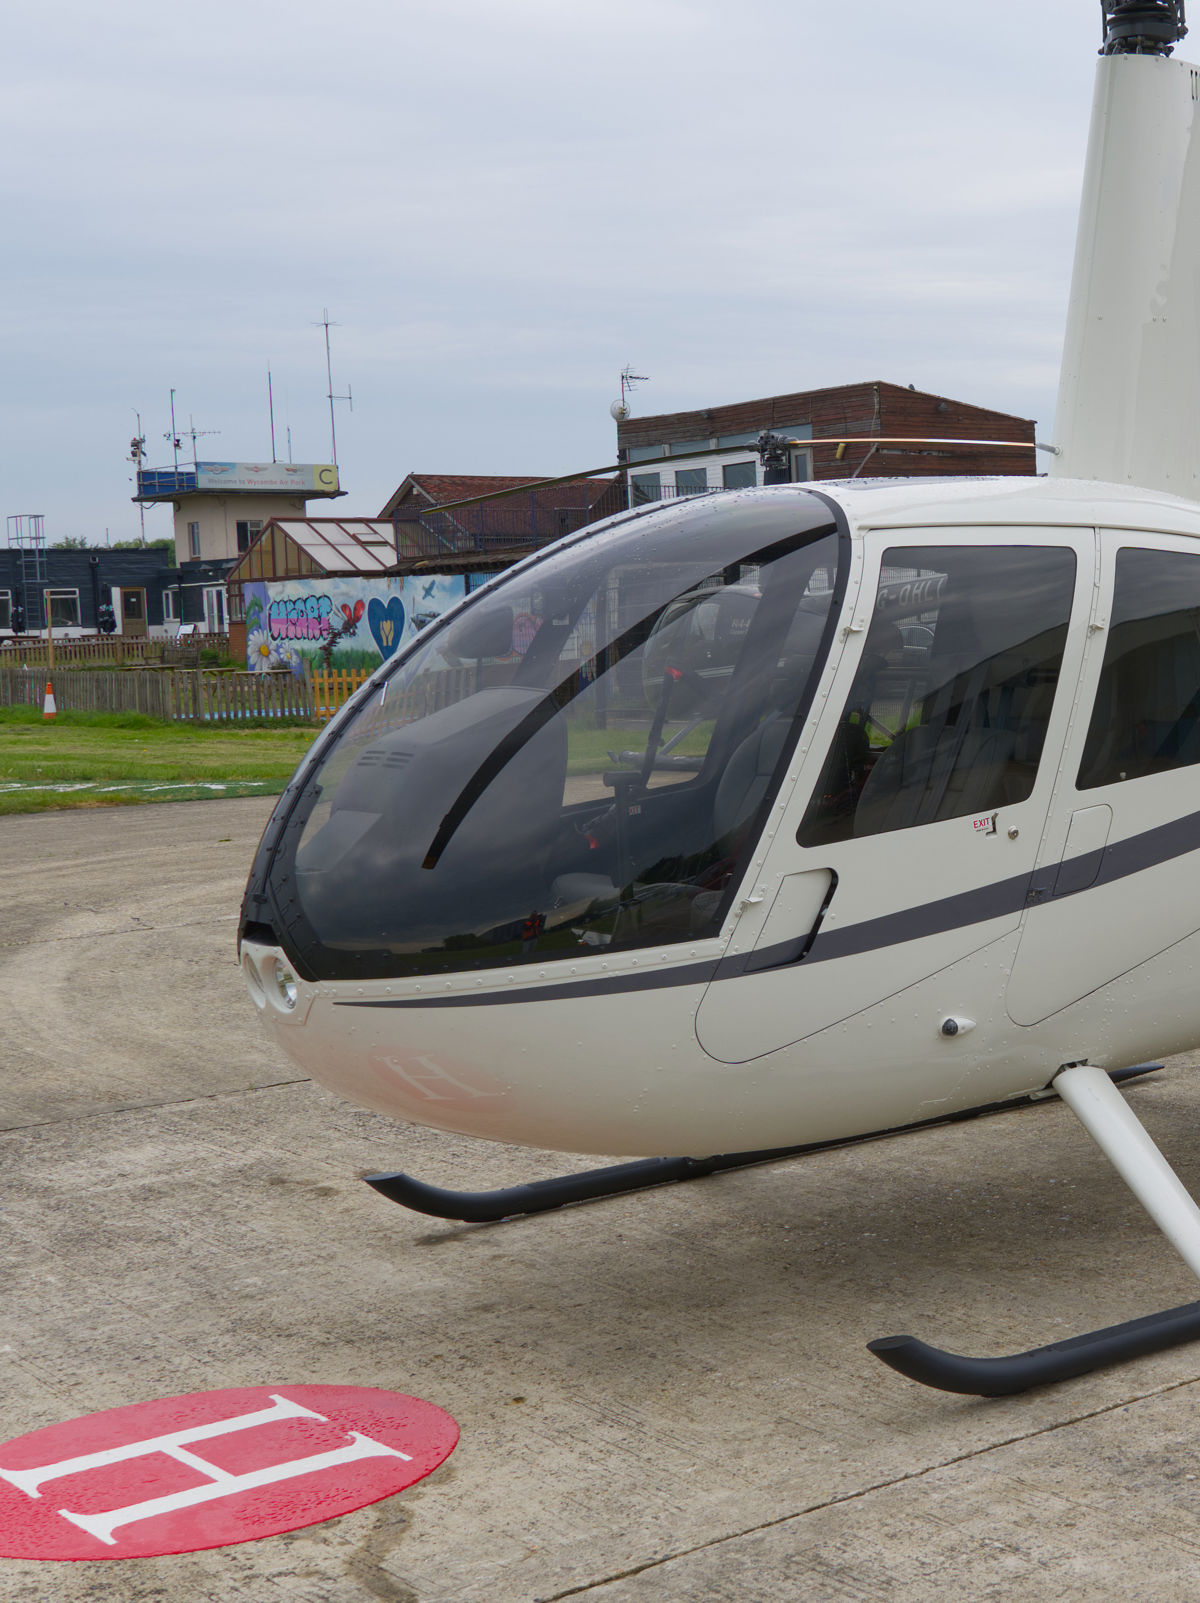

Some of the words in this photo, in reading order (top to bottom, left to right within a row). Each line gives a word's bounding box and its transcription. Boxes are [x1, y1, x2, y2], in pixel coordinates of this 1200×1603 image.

[319, 468, 333, 485] C
[973, 817, 990, 829] EXIT
[0, 1393, 413, 1545] H
